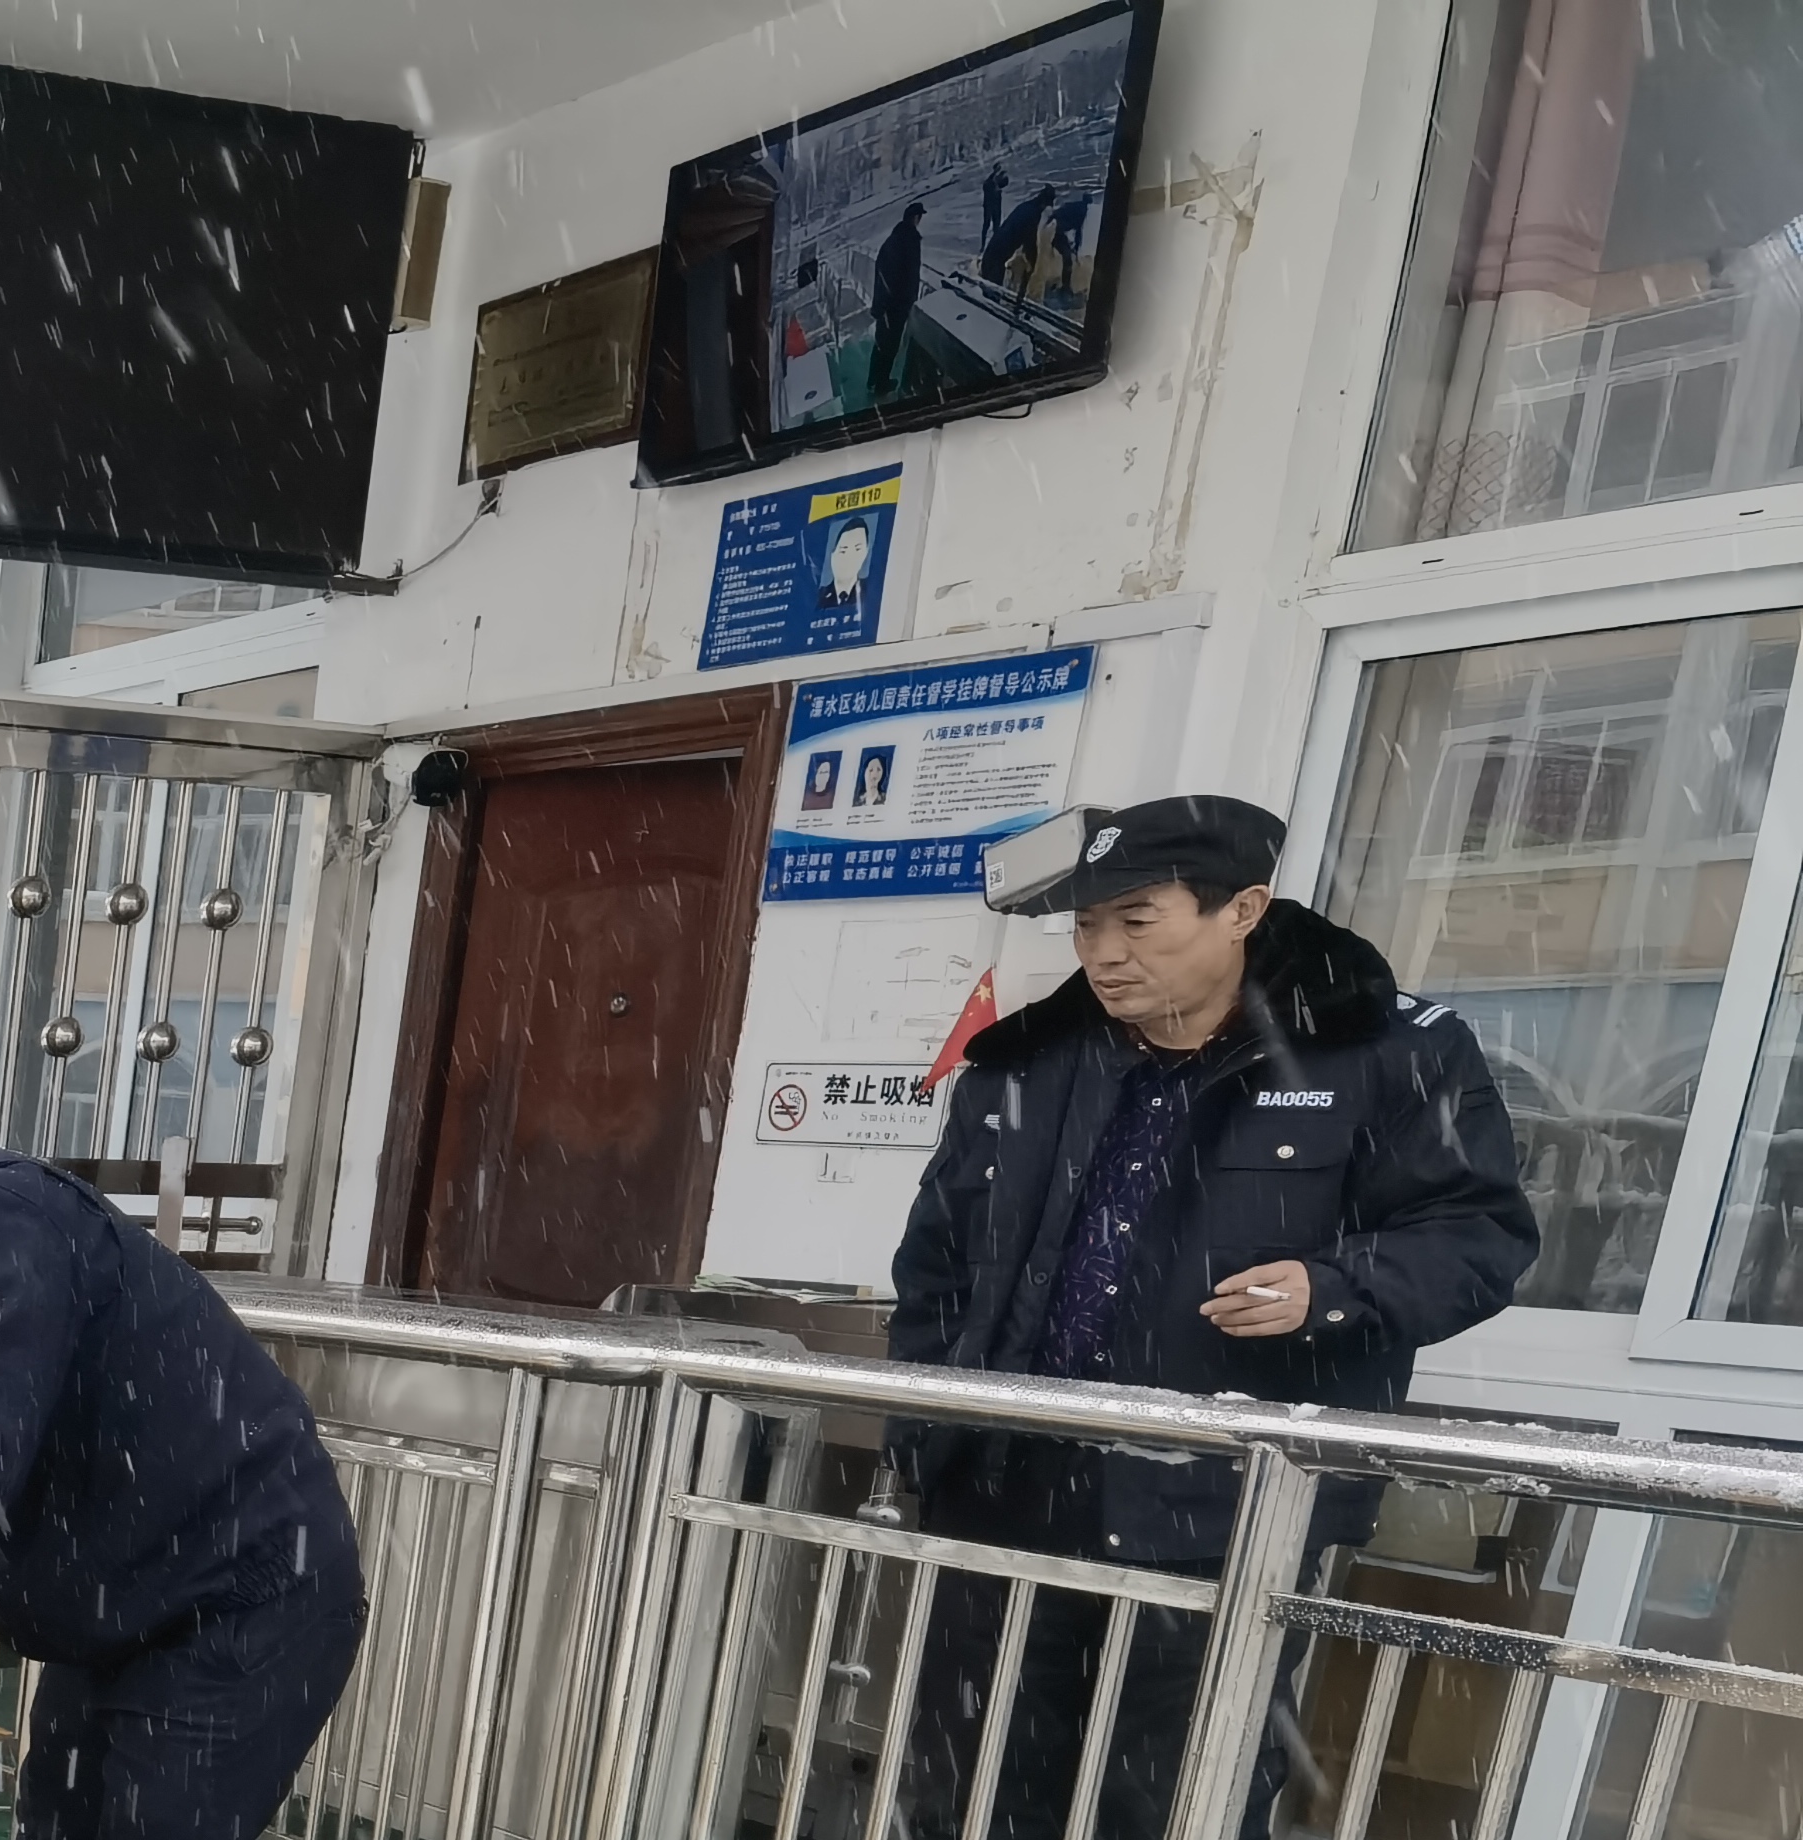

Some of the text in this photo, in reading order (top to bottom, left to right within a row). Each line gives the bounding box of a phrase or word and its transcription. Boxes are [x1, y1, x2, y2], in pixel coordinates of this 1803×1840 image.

[822, 1073, 936, 1108] 禁止吸烟
[1255, 1090, 1335, 1108] BA0055
[859, 1111, 928, 1126] Smoking
